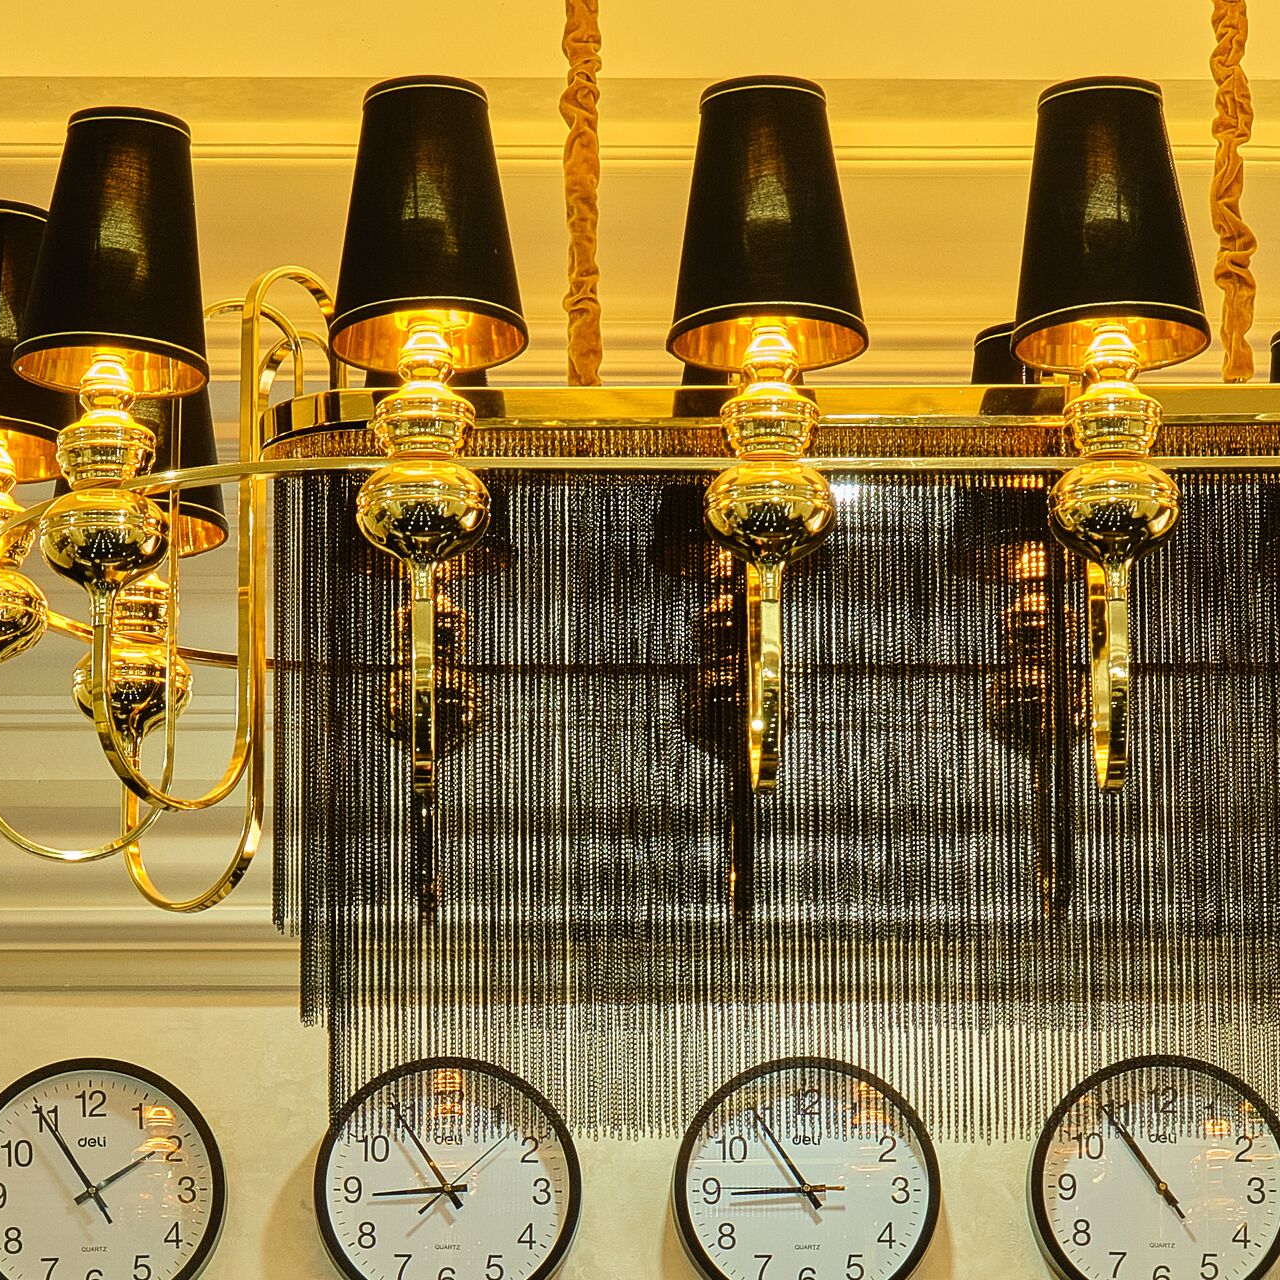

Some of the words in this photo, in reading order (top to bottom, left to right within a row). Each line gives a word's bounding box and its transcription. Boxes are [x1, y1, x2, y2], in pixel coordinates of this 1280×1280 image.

[75, 1090, 107, 1117] 12
[132, 1103, 144, 1129] 1
[78, 1137, 106, 1147] deli
[165, 1136, 182, 1162] 2
[356, 1135, 389, 1162] 10
[435, 1135, 463, 1145] deli
[521, 1137, 539, 1163] 2
[715, 1136, 747, 1163] 10
[792, 1135, 820, 1145] deli
[879, 1136, 897, 1162] 2
[1072, 1133, 1103, 1159] 10
[1149, 1133, 1177, 1143] deli
[1235, 1136, 1253, 1162] 2
[1, 1140, 33, 1167] 10
[178, 1176, 196, 1203] 3
[344, 1177, 362, 1203] 9
[533, 1178, 551, 1205] 3
[703, 1178, 721, 1204] 9
[891, 1177, 910, 1204] 3
[1058, 1174, 1076, 1200] 9
[1247, 1177, 1265, 1204] 3
[4, 1227, 22, 1254] 8
[164, 1222, 182, 1248] 4
[358, 1222, 376, 1249] 8
[517, 1223, 536, 1249] 4
[718, 1223, 736, 1250] 8
[877, 1222, 896, 1249] 4
[1073, 1219, 1091, 1246] 8
[1232, 1222, 1250, 1249] 4
[394, 1254, 412, 1280] 7
[486, 1255, 504, 1280] 5
[754, 1255, 772, 1280] 7
[846, 1254, 864, 1280] 5
[1109, 1252, 1127, 1278] 7
[1200, 1254, 1219, 1280] 5
